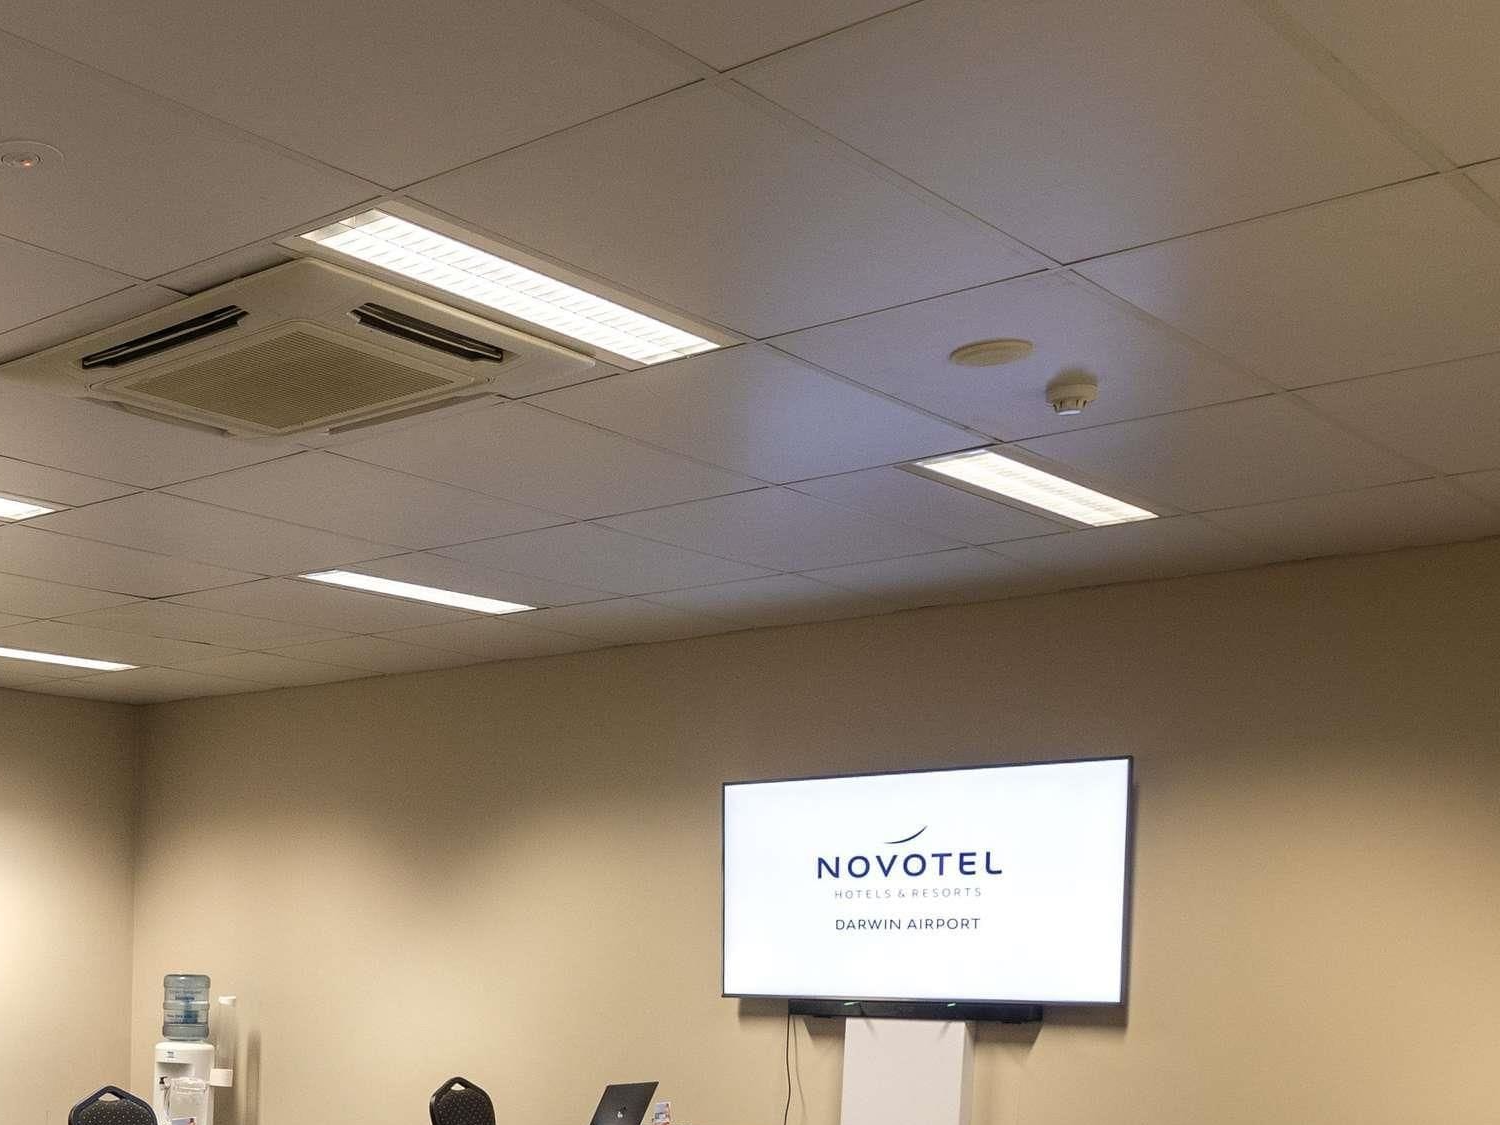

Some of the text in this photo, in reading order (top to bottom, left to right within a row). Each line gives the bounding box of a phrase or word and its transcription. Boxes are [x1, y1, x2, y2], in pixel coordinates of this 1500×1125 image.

[817, 851, 1003, 880] NOVOTEL
[834, 887, 982, 899] HOTELS & RESORTS
[835, 917, 981, 931] DARWIN AIRPORT
